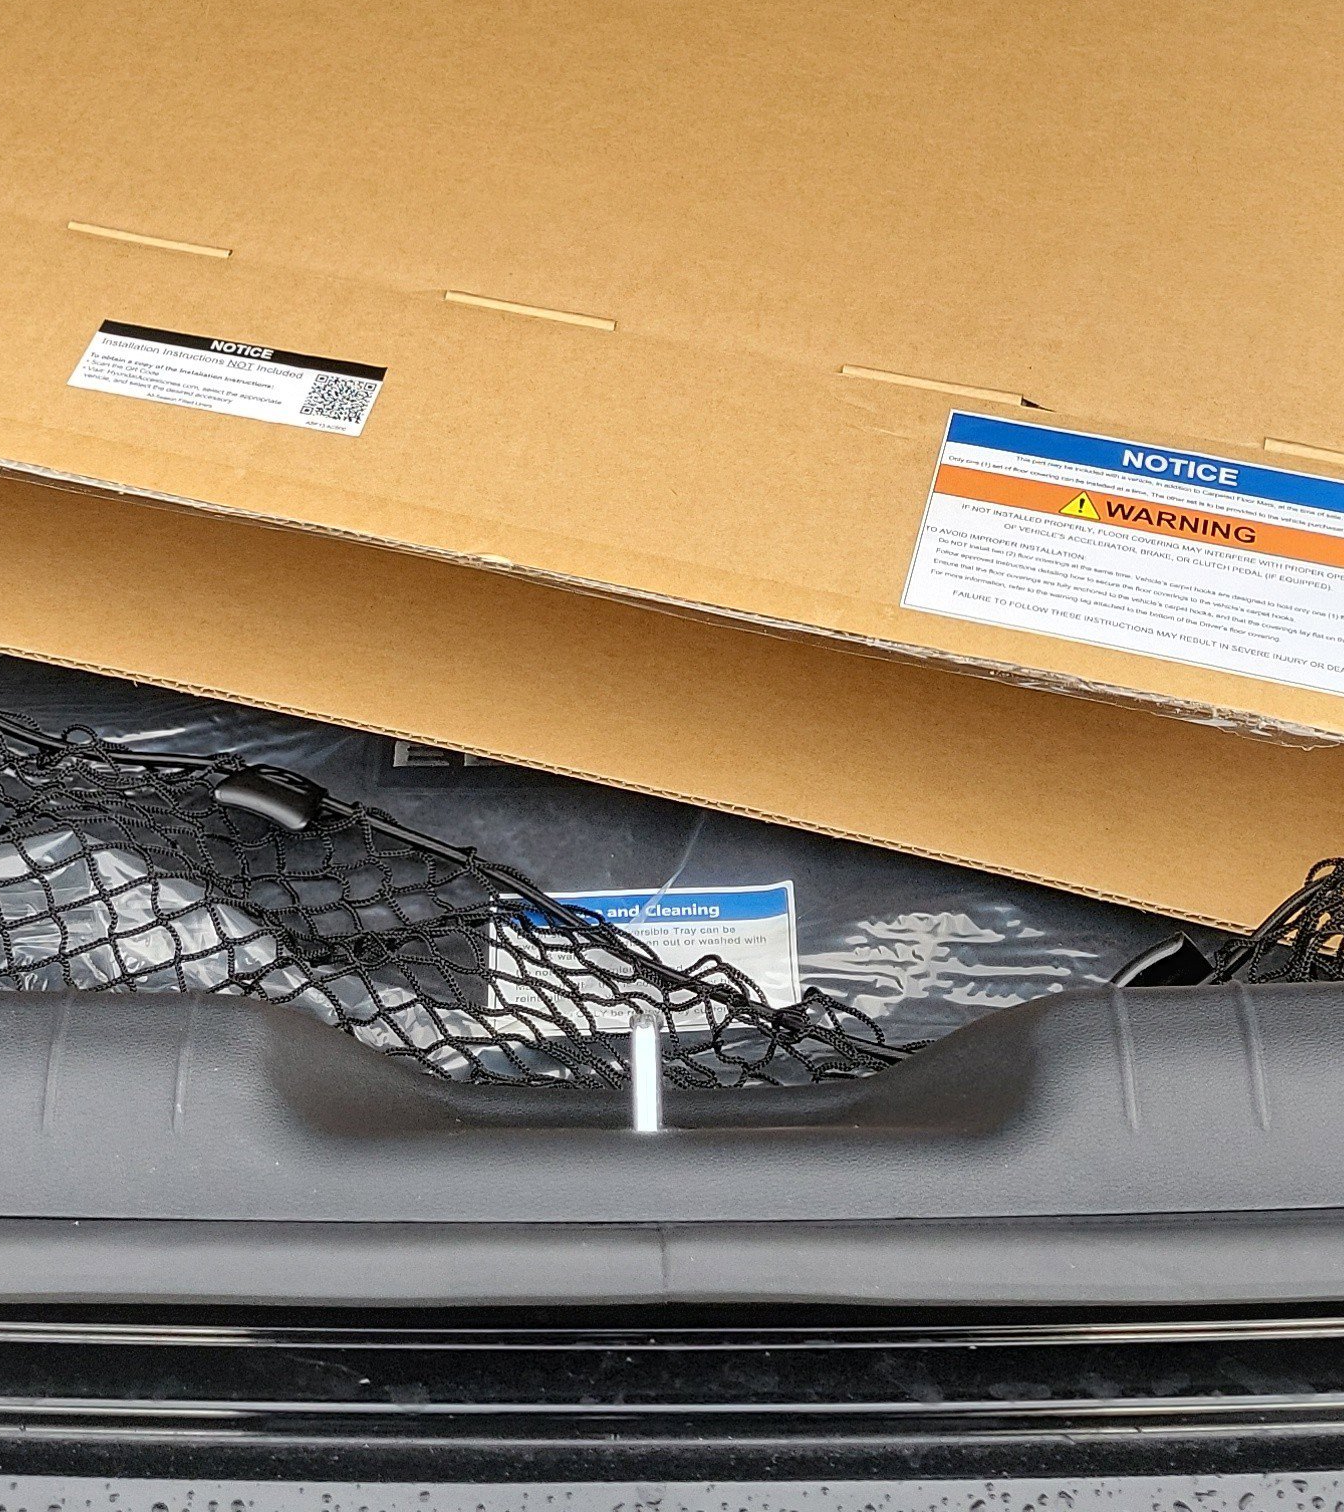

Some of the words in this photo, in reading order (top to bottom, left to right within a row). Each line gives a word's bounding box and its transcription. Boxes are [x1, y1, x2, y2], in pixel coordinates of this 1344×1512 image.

[100, 337, 161, 354] Installation
[161, 348, 226, 365] Instructions
[225, 359, 255, 371] NOT
[255, 364, 304, 379] Included
[208, 339, 275, 360] NOTICE
[100, 354, 127, 363] obtain
[132, 360, 154, 369] copy
[178, 368, 223, 380] Installation
[1121, 448, 1239, 487] NOTICE
[1103, 500, 1257, 544] WARNING
[924, 523, 938, 533] TO
[938, 526, 968, 539] AVOID
[968, 532, 1018, 548] IMPROPER
[961, 502, 970, 510] IF
[971, 504, 991, 514] NOT
[992, 508, 1042, 524] INSTALLED
[1043, 517, 1095, 535] PROPERLY,
[1096, 527, 1129, 541] FLOOR
[1130, 534, 1180, 551] COVERING
[1181, 544, 1202, 555] MAY
[1203, 548, 1256, 565] INTERFERE
[1257, 558, 1282, 570] WITH
[1284, 563, 1324, 578] PROPER
[951, 588, 992, 603] FAILURE
[993, 596, 1007, 606] TO
[1008, 599, 1049, 614] FOLLOW
[1049, 607, 1082, 621] THESE
[1082, 614, 1154, 636] INSTRUCTIONS
[1155, 628, 1177, 640] MAY
[1178, 633, 1217, 648] RESULT
[1218, 641, 1229, 651] IN
[1230, 643, 1270, 659] SEVERE
[1272, 652, 1307, 666] INJURY
[1309, 659, 1324, 670] OR
[607, 904, 640, 919] and
[645, 903, 720, 919] Cleaning
[663, 937, 682, 946] out
[684, 938, 695, 946] or
[698, 935, 741, 946] washed
[744, 934, 767, 945] with
[673, 926, 697, 937] Tray
[722, 926, 736, 935] be
